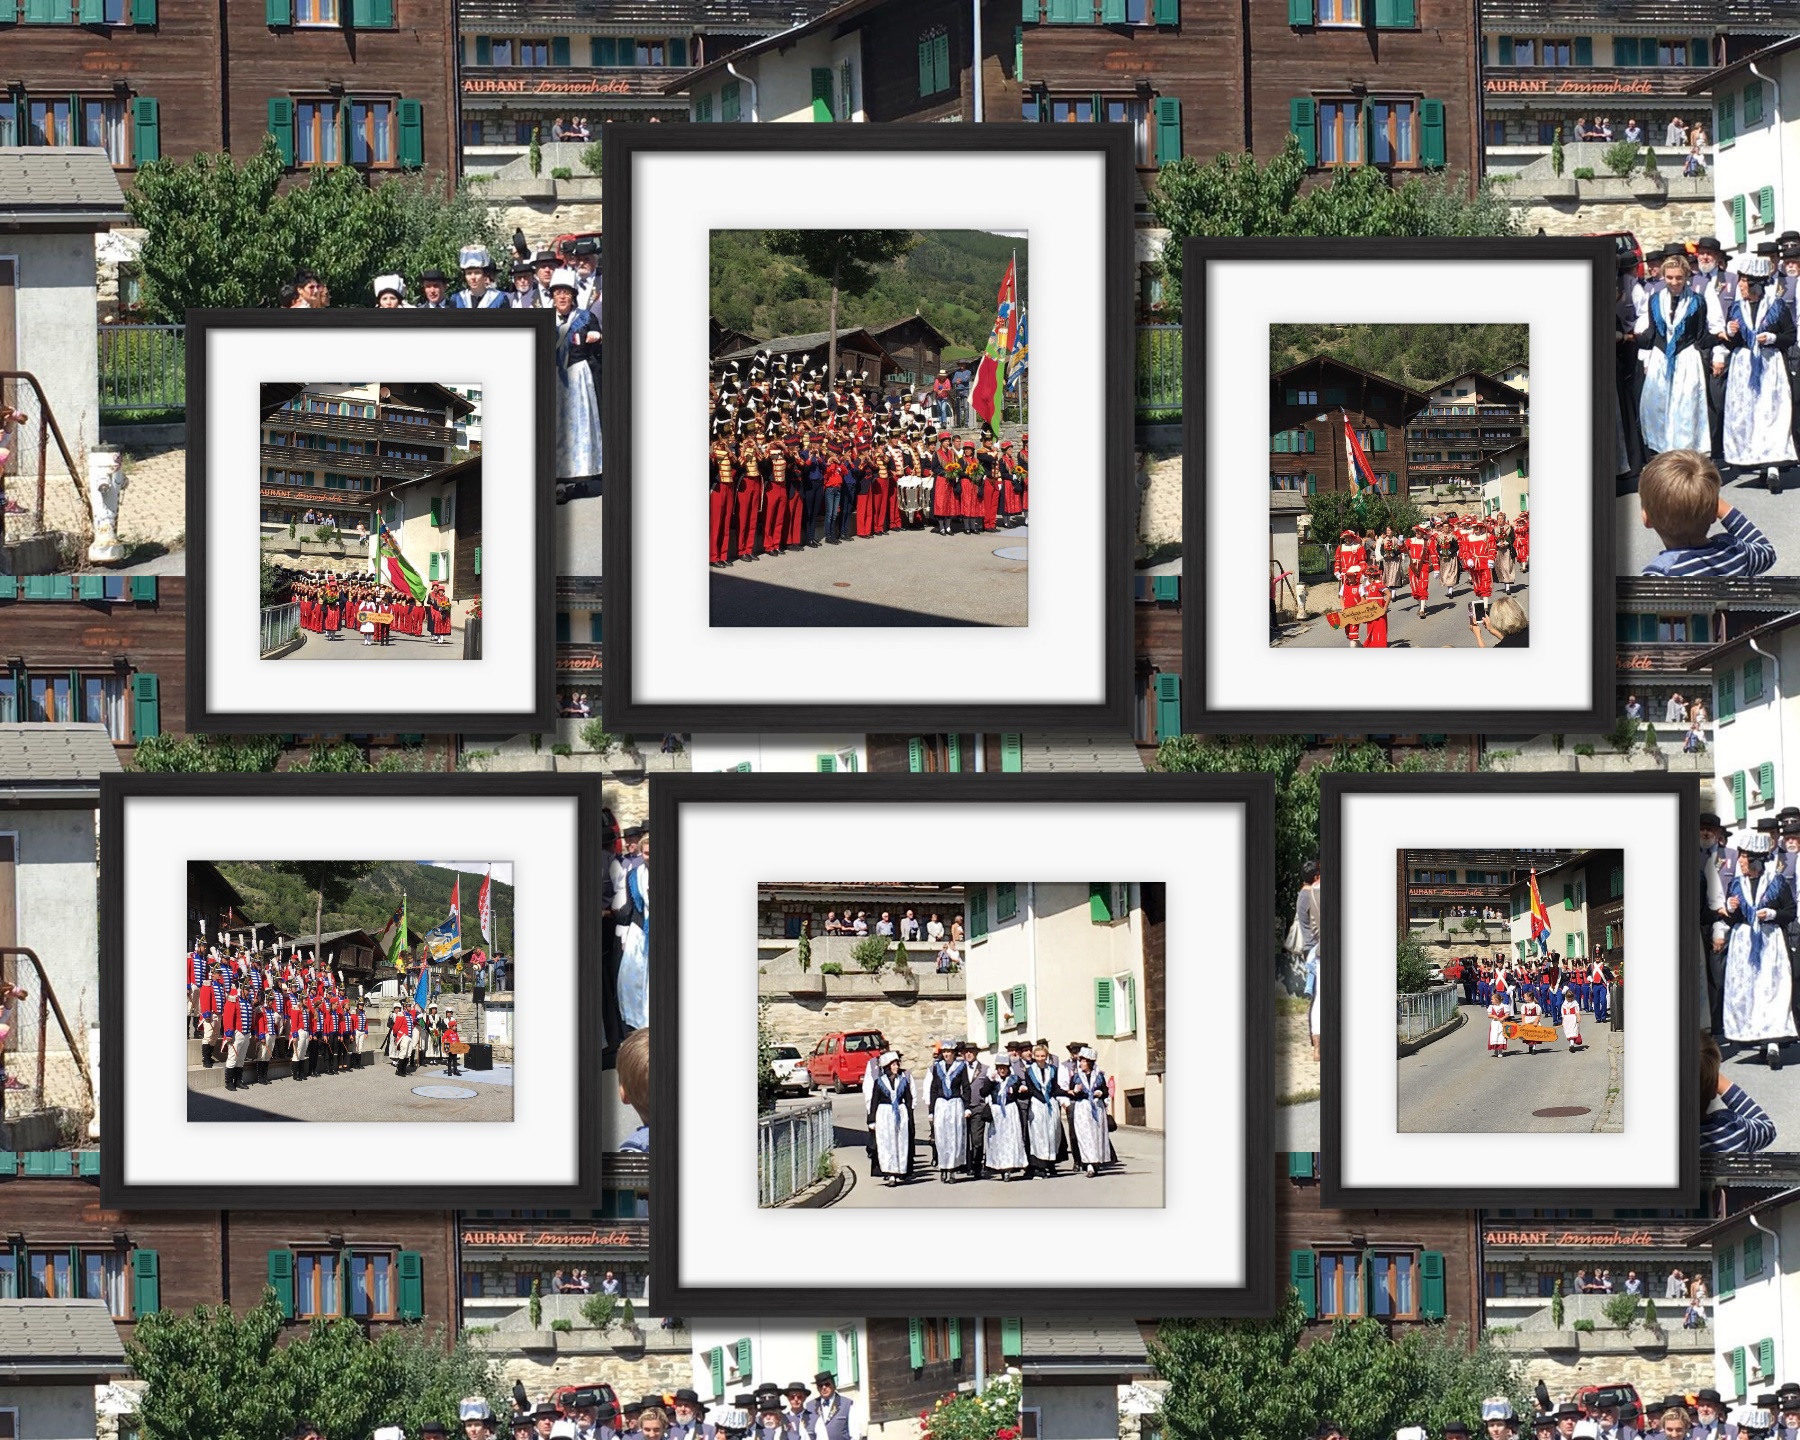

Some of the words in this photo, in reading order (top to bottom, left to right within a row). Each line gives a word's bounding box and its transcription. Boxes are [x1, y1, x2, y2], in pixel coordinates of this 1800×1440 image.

[461, 80, 526, 92] AURANT
[532, 79, 631, 93] Sonnenhalde
[1484, 80, 1549, 92] AURANT
[1555, 79, 1654, 93] Sonnenhalde
[461, 1232, 526, 1244] AURANT
[532, 1231, 631, 1245] Sonnenhalde
[1484, 1232, 1549, 1244] AURANT
[1555, 1231, 1654, 1245] Sonnenhalde
